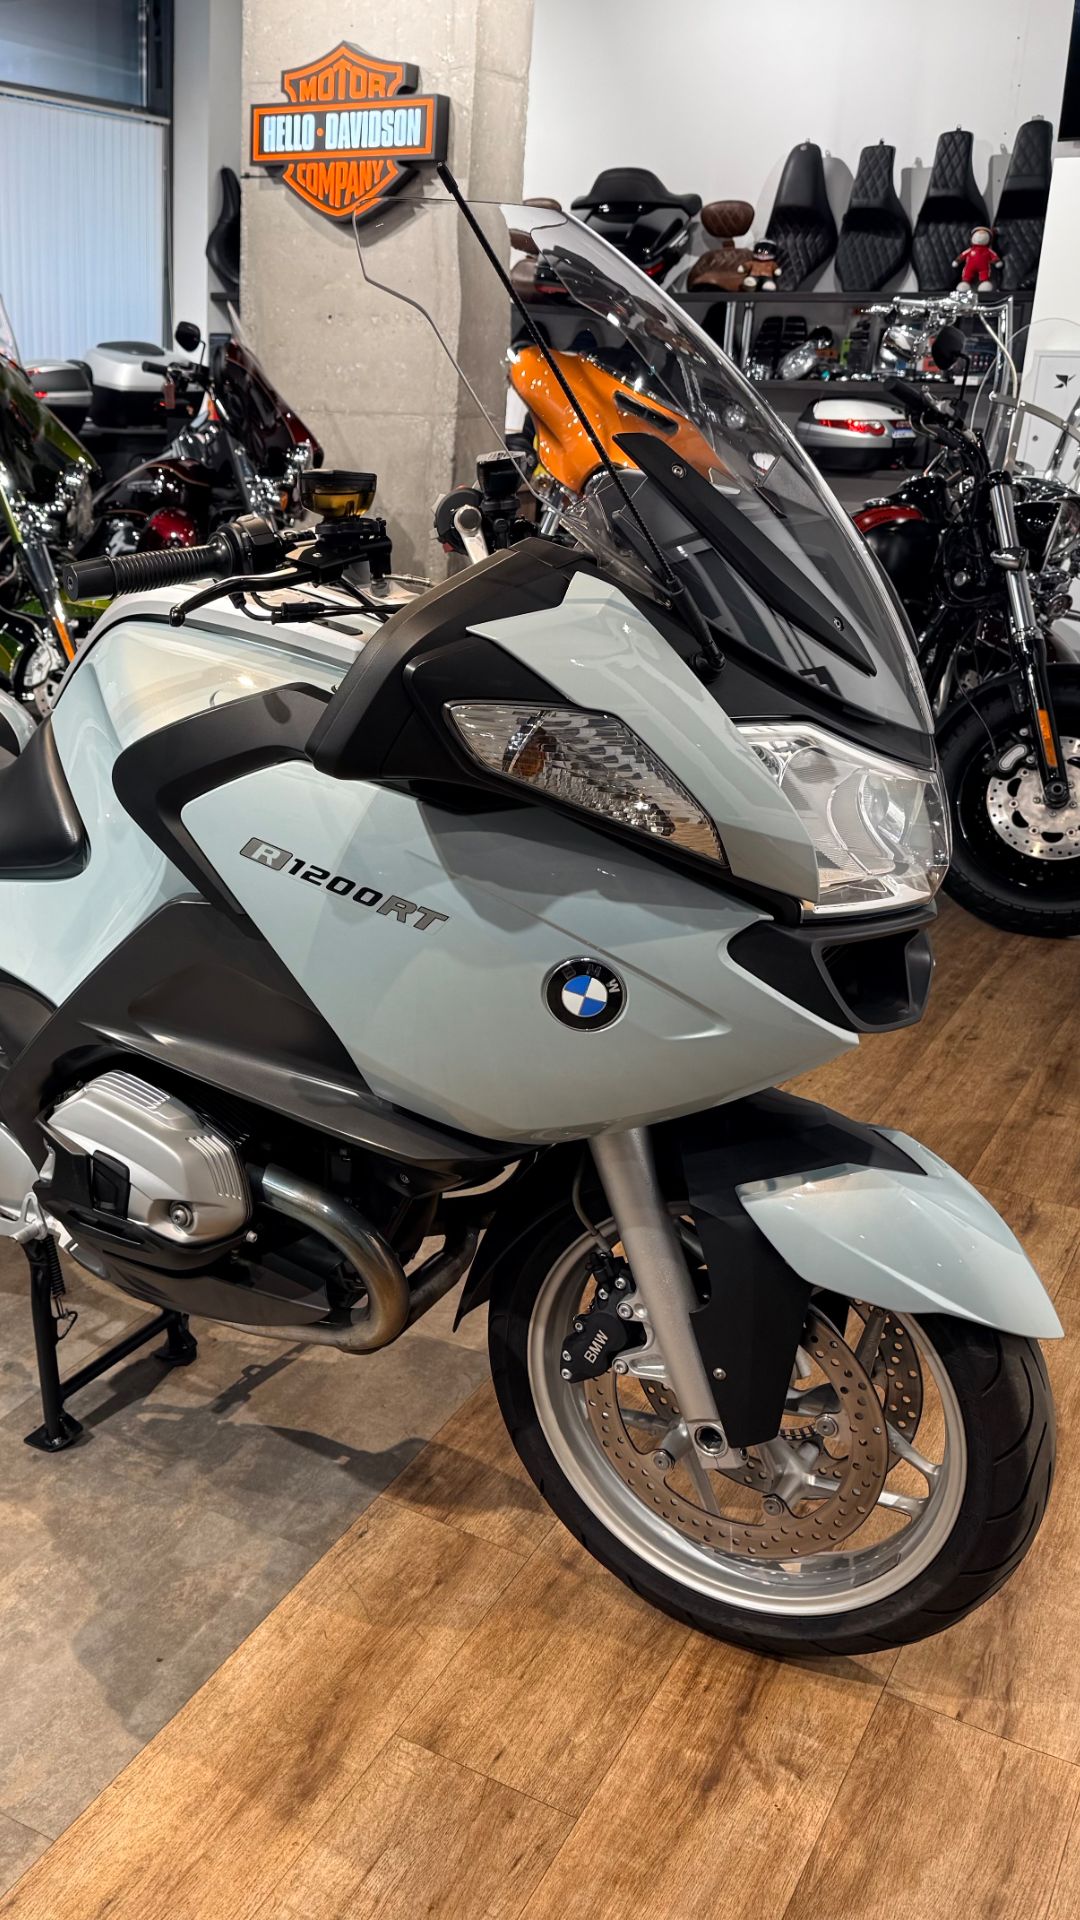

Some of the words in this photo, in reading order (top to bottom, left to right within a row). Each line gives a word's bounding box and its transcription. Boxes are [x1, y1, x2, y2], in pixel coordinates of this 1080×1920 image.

[300, 58, 387, 102] MOTOR
[263, 113, 316, 153] HELLO
[325, 108, 422, 150] DAVIDSON
[297, 160, 385, 208] COMPANY
[561, 963, 621, 993] BMW
[583, 1329, 609, 1364] BMW
